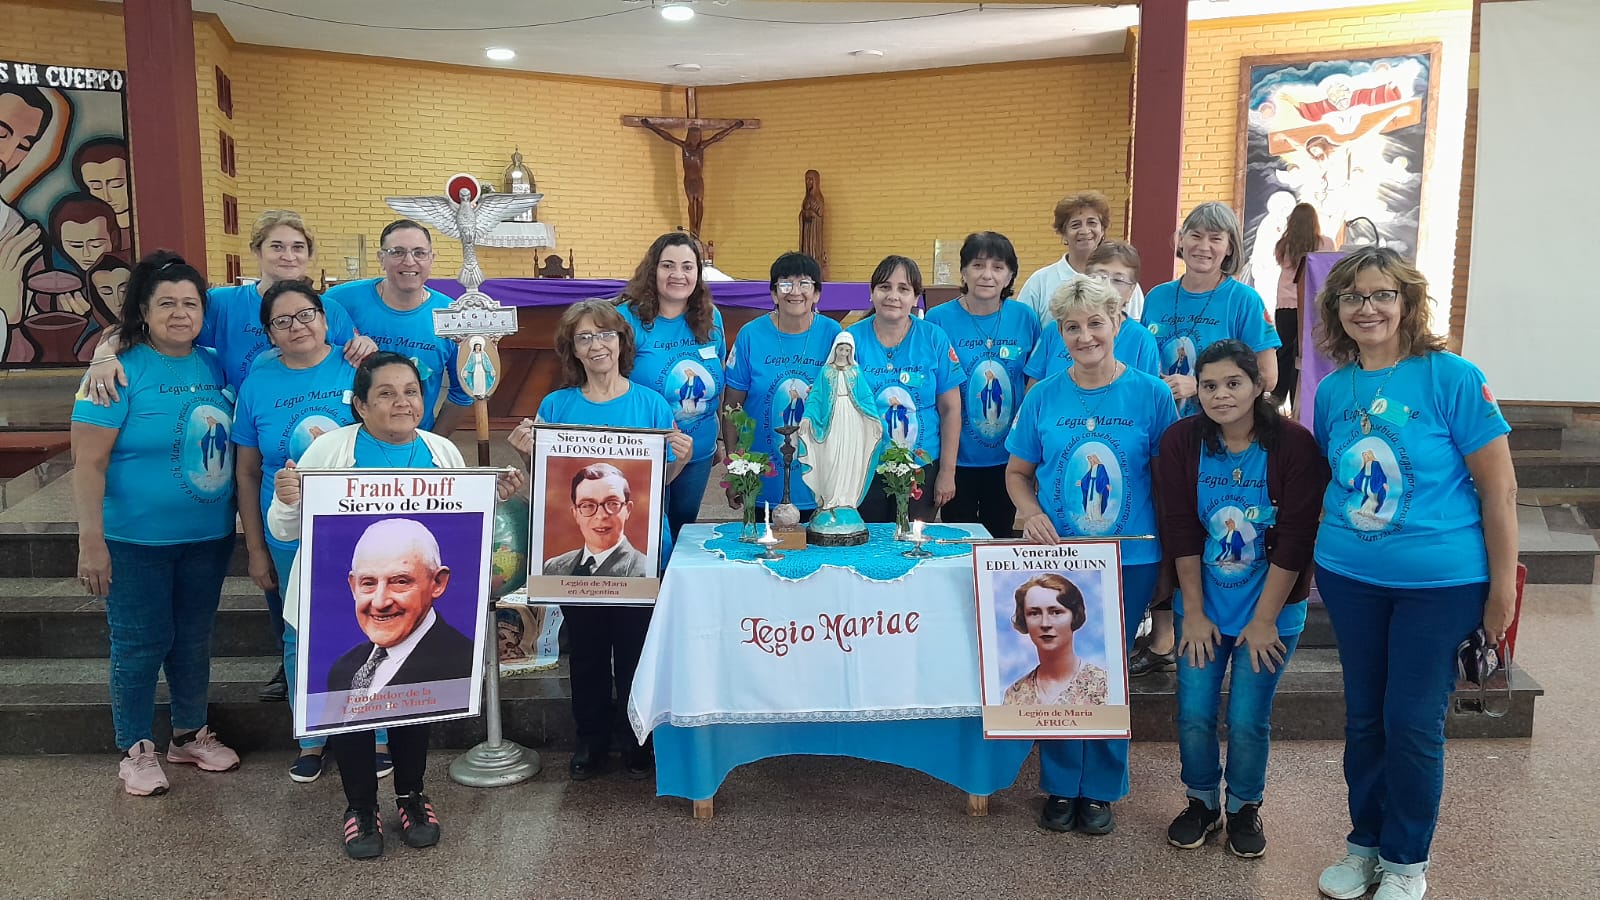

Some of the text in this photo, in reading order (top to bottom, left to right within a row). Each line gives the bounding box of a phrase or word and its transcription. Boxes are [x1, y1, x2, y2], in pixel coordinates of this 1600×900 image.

[46, 66, 122, 90] CUERPO
[243, 323, 263, 336] Leg
[444, 320, 506, 328] MARIAE
[396, 336, 436, 351] Mariae
[654, 340, 678, 351] Legio
[764, 355, 792, 366] Legio
[160, 384, 188, 396] Legio
[274, 388, 343, 409] Legio Maria
[1092, 415, 1134, 427] Mariae
[557, 432, 643, 446] Siervo de Dios
[550, 444, 650, 456] ALFONSO LAMBE
[1198, 472, 1230, 488] Legio
[345, 477, 456, 498] Frank Duff
[338, 498, 463, 512] Siervo de Dios
[1012, 546, 1079, 558] Venerable
[986, 560, 1107, 571] EDEL MARY QUINN
[740, 610, 920, 657] Legio Mariae
[347, 687, 432, 704] Fundador de la
[385, 701, 398, 710] de
[1019, 709, 1049, 718] Legión
[1035, 718, 1078, 726] ÁFRICA
